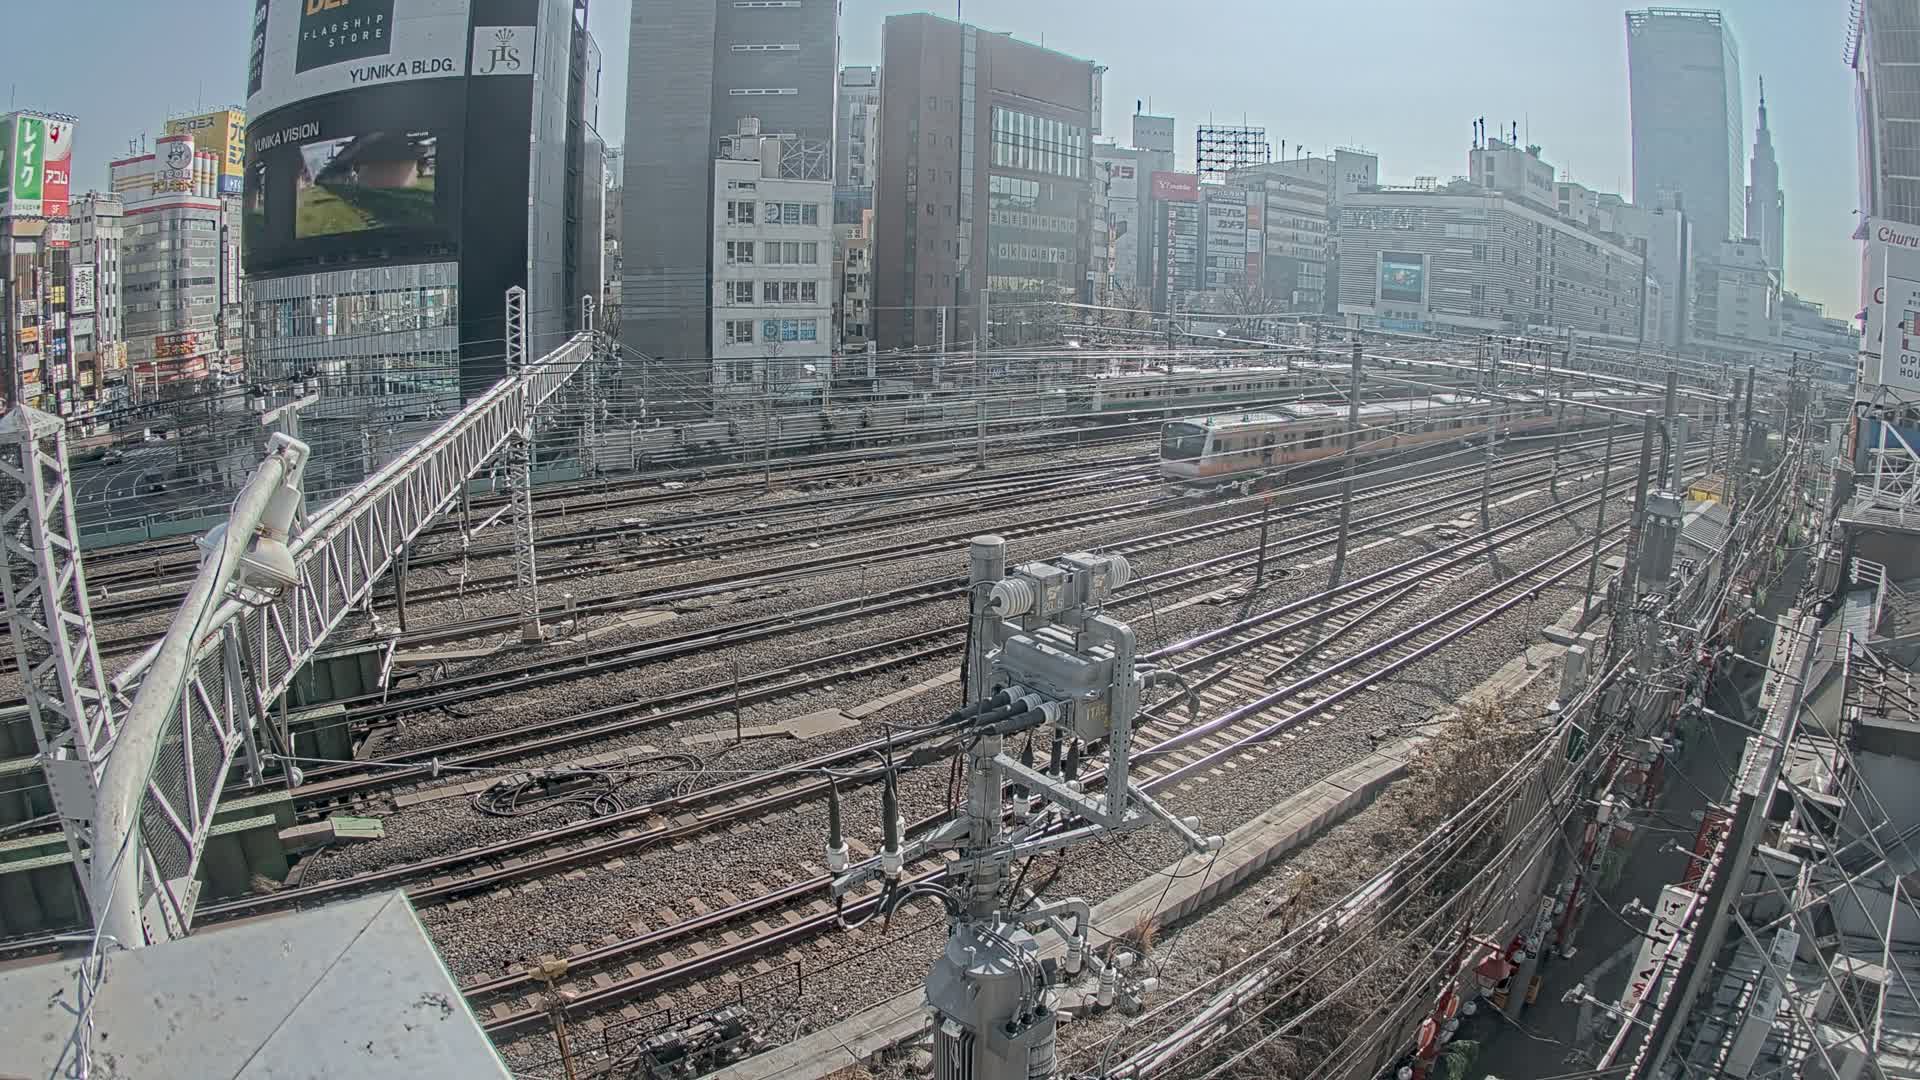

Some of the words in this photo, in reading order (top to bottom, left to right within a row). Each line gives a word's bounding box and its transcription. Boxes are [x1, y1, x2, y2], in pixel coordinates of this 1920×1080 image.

[303, 14, 384, 41] FLAGSHIP
[328, 28, 383, 48] STORE
[349, 62, 408, 84] YUNIKA
[411, 57, 456, 75] BLDG.
[254, 129, 282, 153] YUNIKA
[281, 120, 320, 145] VISION
[20, 120, 37, 188] レイク
[45, 169, 68, 185] アコム
